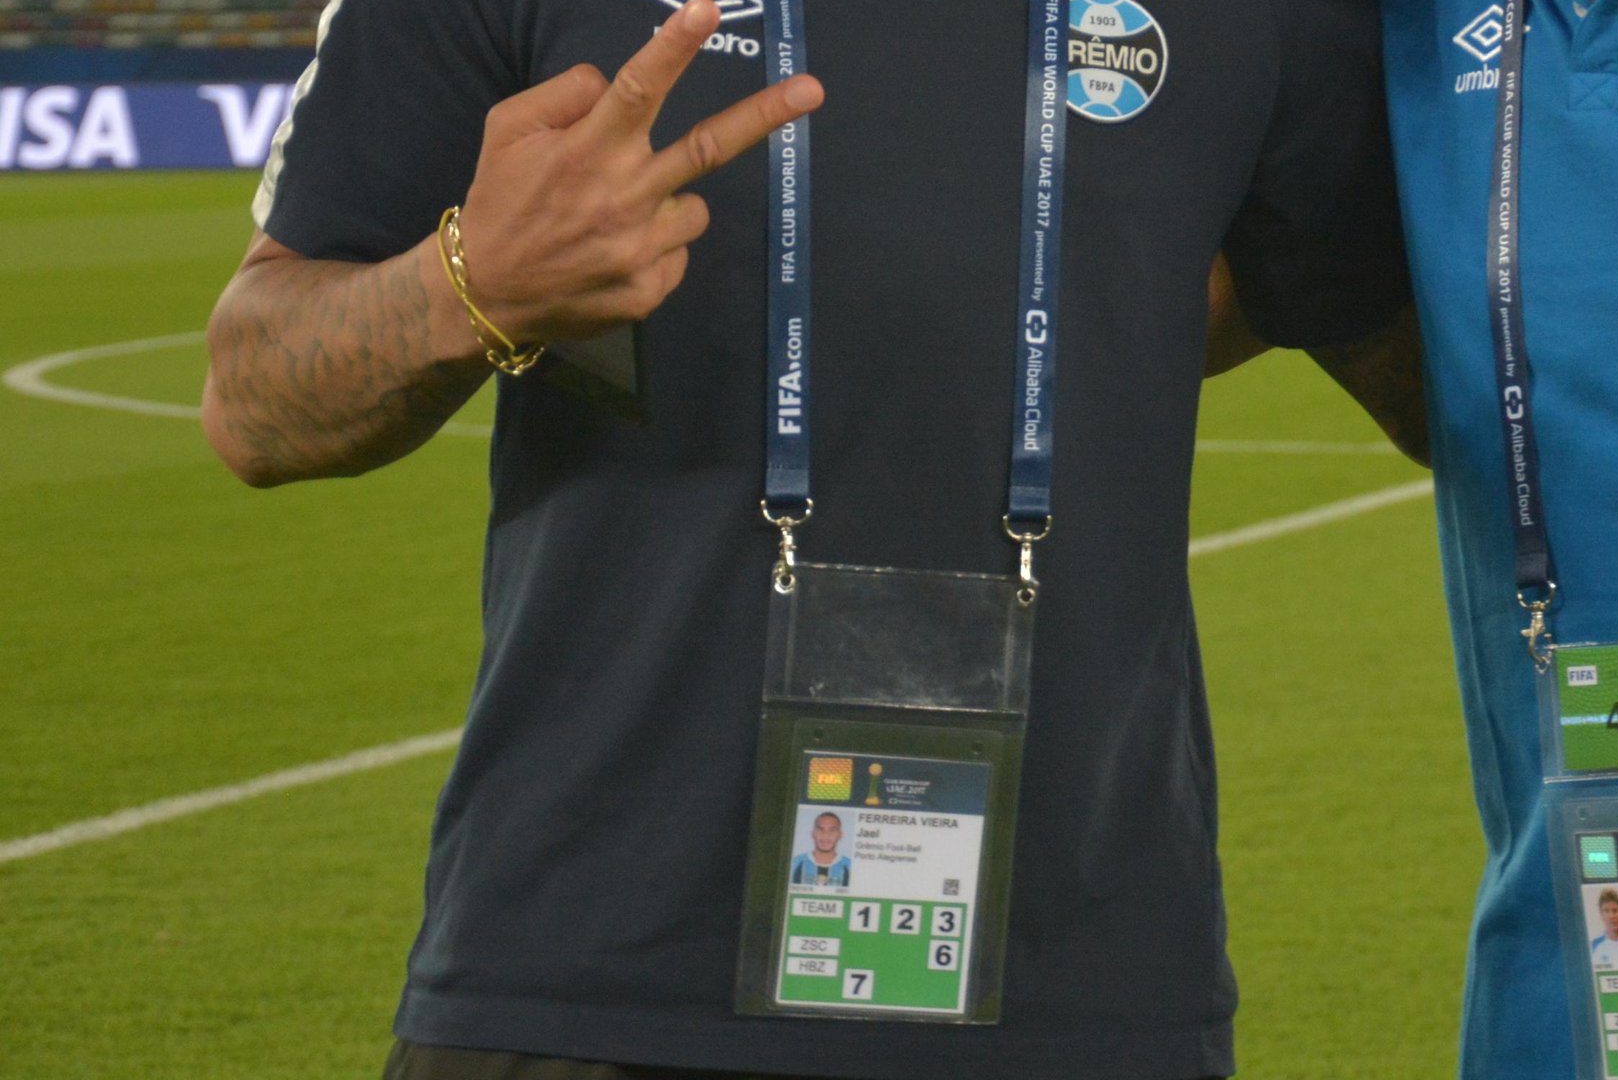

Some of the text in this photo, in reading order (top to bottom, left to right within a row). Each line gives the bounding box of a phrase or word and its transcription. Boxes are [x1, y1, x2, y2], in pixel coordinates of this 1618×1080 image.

[1090, 15, 1116, 26] 1903
[778, 42, 794, 76] 2017
[1044, 27, 1058, 61] CLUB
[1068, 35, 1158, 74] RÊMIO
[1042, 65, 1057, 119] WORLD
[0, 85, 139, 168] ISA
[1040, 123, 1054, 151] CUP
[1037, 154, 1053, 187] UAE
[781, 122, 797, 283] FIFA CLUB WORLD CU
[1036, 191, 1051, 228] 2017
[1033, 230, 1046, 285] presented
[1031, 286, 1044, 303] by
[1498, 71, 1534, 527] FIFA CLUB WORLD CUP UAE 2017 presented by Alibaba Cloud
[1026, 347, 1044, 406] Alibaba
[1024, 408, 1041, 450] Cloud
[1569, 670, 1595, 682] FIFA
[856, 828, 880, 838] Jael
[858, 813, 959, 829] FERREIRA VIEIRA
[800, 901, 955, 933] TEAM 1 2 3
[799, 961, 826, 973] HBZ
[800, 939, 952, 966] ZSC 6
[850, 974, 867, 995] 7
